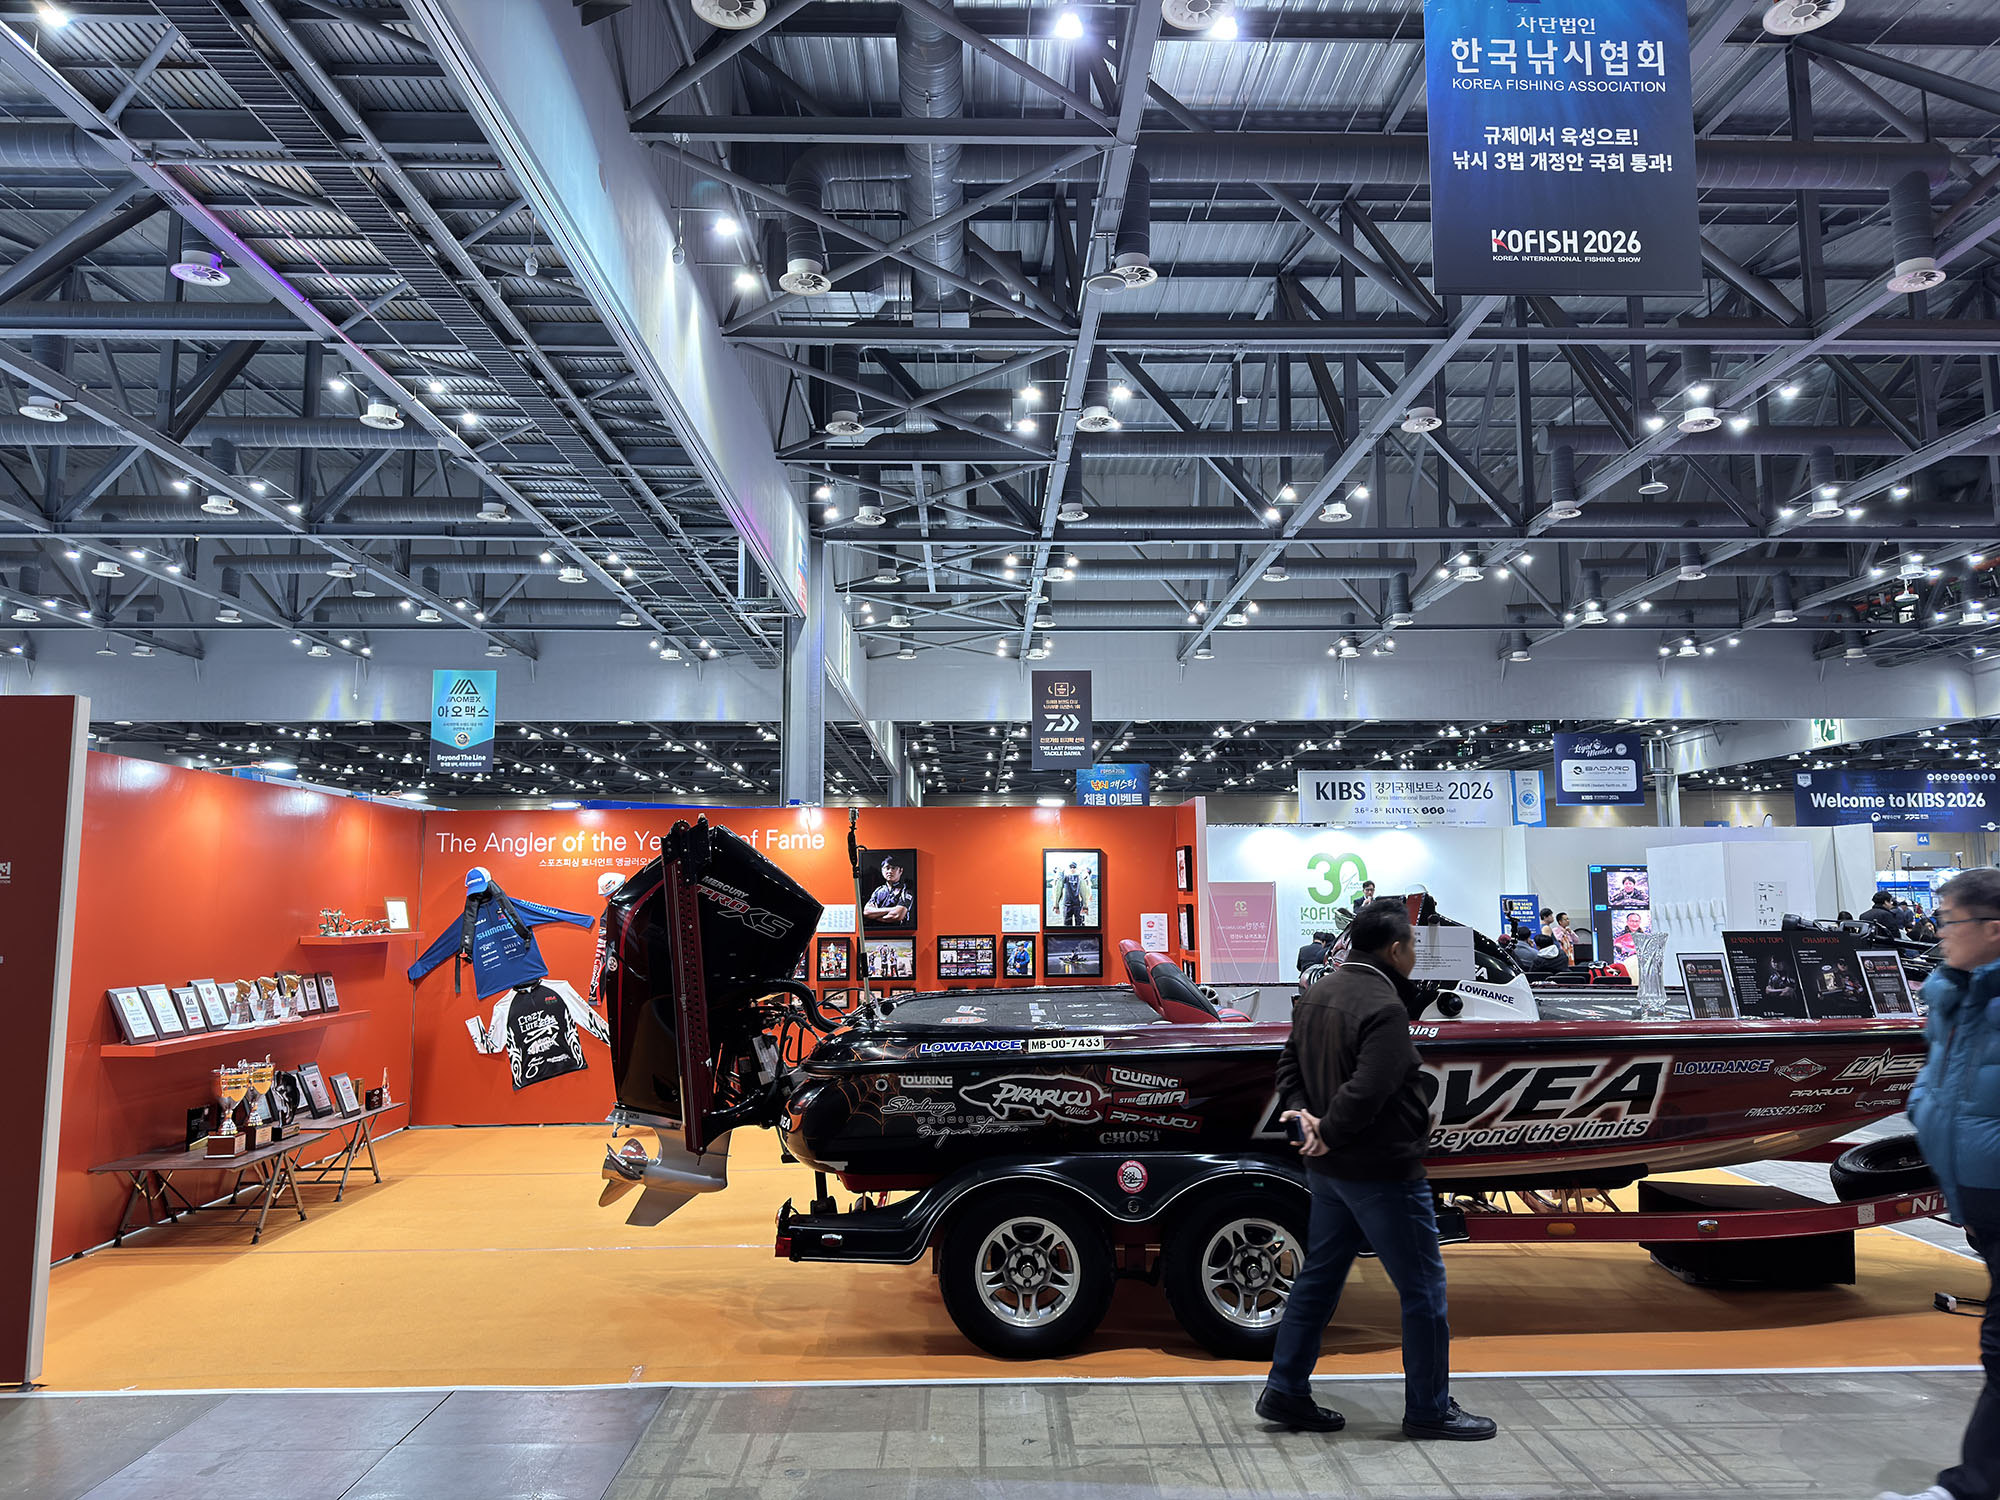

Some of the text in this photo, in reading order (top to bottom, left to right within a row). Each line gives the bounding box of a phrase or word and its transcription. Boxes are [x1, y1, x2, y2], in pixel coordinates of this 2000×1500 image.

[1517, 17, 1596, 35] 사단법인
[1452, 78, 1667, 93] KOREA FISHING ASSOCIATION
[1483, 126, 1640, 147] 규제에서 육성으로!
[1452, 151, 1673, 173] 낚시 3법 개정안 국회 통과!
[1491, 229, 1642, 254] KOFISH 2026
[437, 705, 489, 717] 아오맥스
[1091, 779, 1109, 791] 낚시
[1315, 781, 1366, 801] KIBS
[1375, 781, 1494, 800] 경기국제보트쇼 2026
[1083, 793, 1143, 806] 체험 이벤트
[1810, 792, 1987, 808] Welcome to KIBS 2026
[435, 830, 663, 857] The Angler of the Ye
[766, 829, 825, 850] Fame
[539, 858, 580, 867] 스포츠피싱
[702, 875, 749, 899] MERCURY
[1307, 852, 1368, 904] 30
[476, 922, 513, 940] SHIMANO
[1802, 936, 1840, 944] CHAMPION
[1459, 983, 1514, 1004] LOWRANCE
[920, 1039, 1025, 1053] LOWRANCE
[1031, 1038, 1101, 1049] MB-00-7433
[1673, 1058, 1775, 1076] LOWRANCE
[899, 1075, 953, 1088] TOURING
[1109, 1067, 1180, 1089] TOURING
[992, 1083, 1092, 1107] PIRARUCU
[1789, 1087, 1854, 1098] PIRARUCU
[1064, 1105, 1091, 1116] Wide
[1110, 1110, 1198, 1129] PIRARUCU
[1099, 1130, 1161, 1145] GHOST
[1428, 1117, 1651, 1153] Beyond the limits
